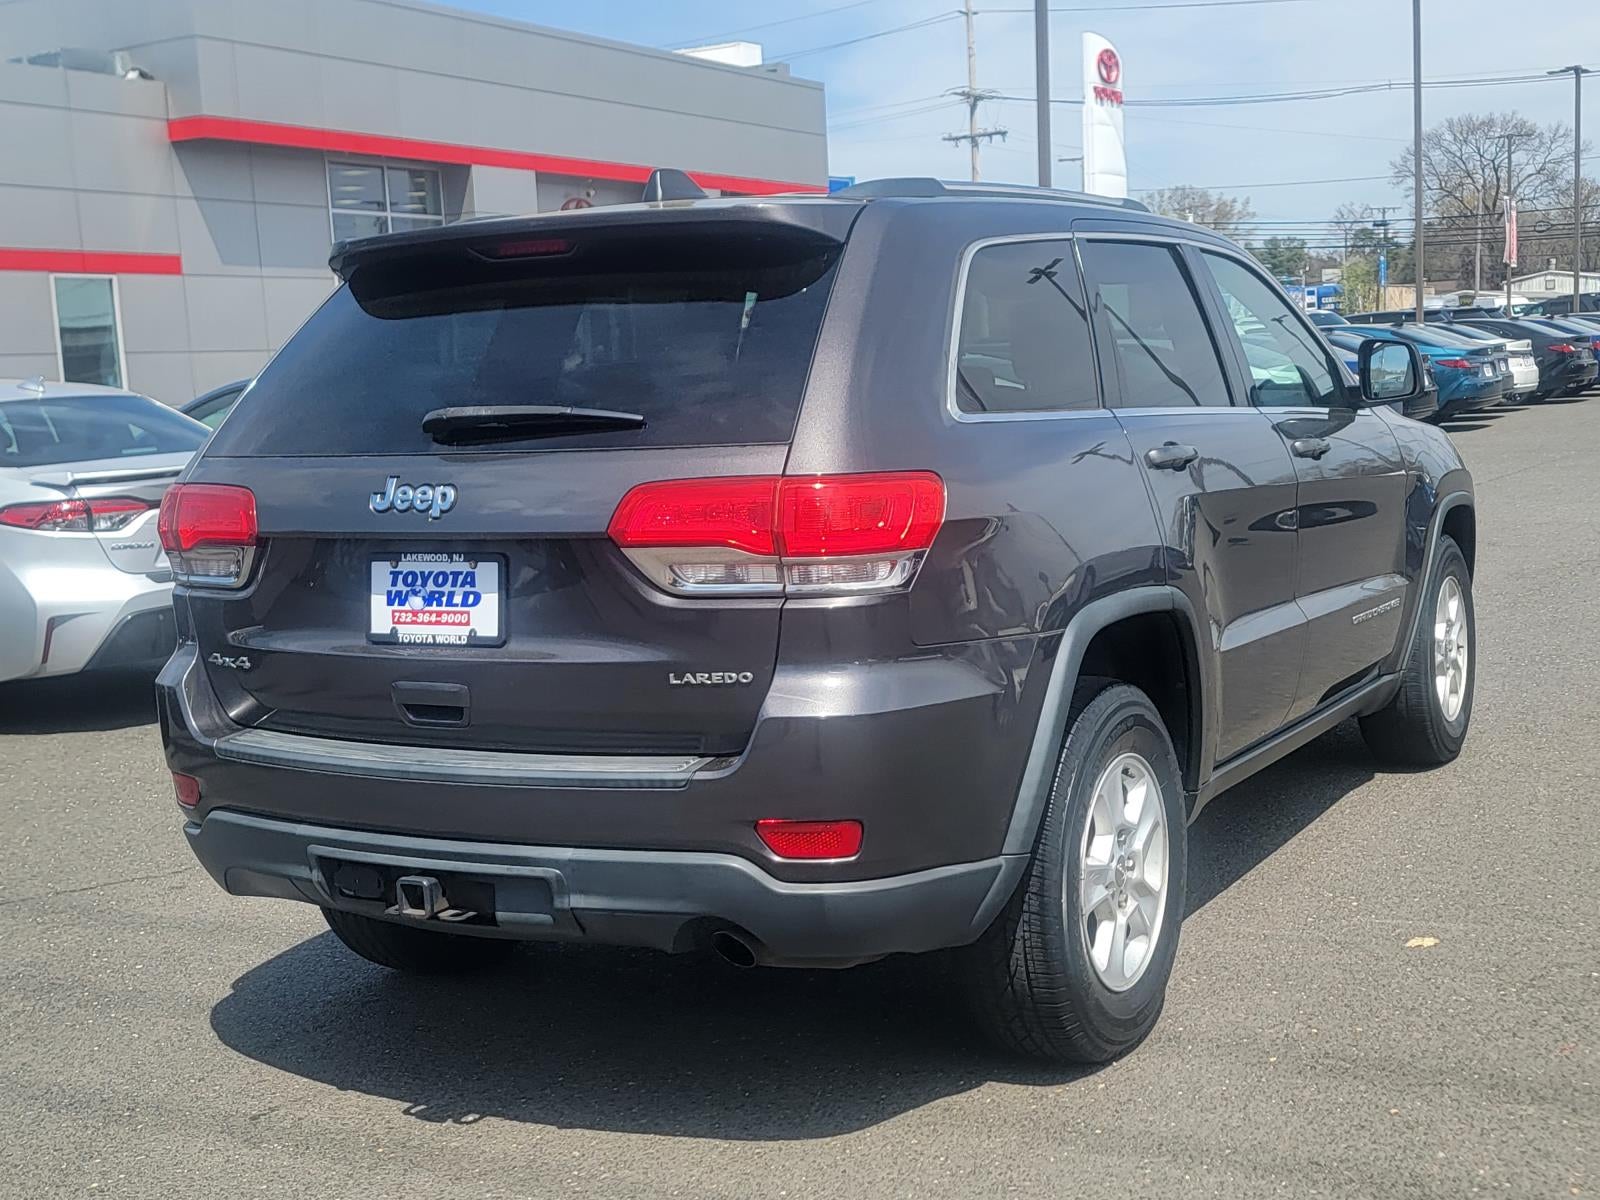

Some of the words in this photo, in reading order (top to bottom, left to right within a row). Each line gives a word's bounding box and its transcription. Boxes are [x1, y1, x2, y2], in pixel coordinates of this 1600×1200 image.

[1093, 85, 1122, 106] TOYOTA
[369, 475, 457, 521] Jeep
[401, 553, 451, 562] LAKEWOOD,
[453, 554, 464, 562] NJ
[389, 570, 477, 588] TOYOTA
[393, 612, 468, 623] 732-364-9000
[398, 633, 434, 644] TOYOTA
[435, 634, 468, 644] WORLD
[669, 671, 754, 684] LAREDO
